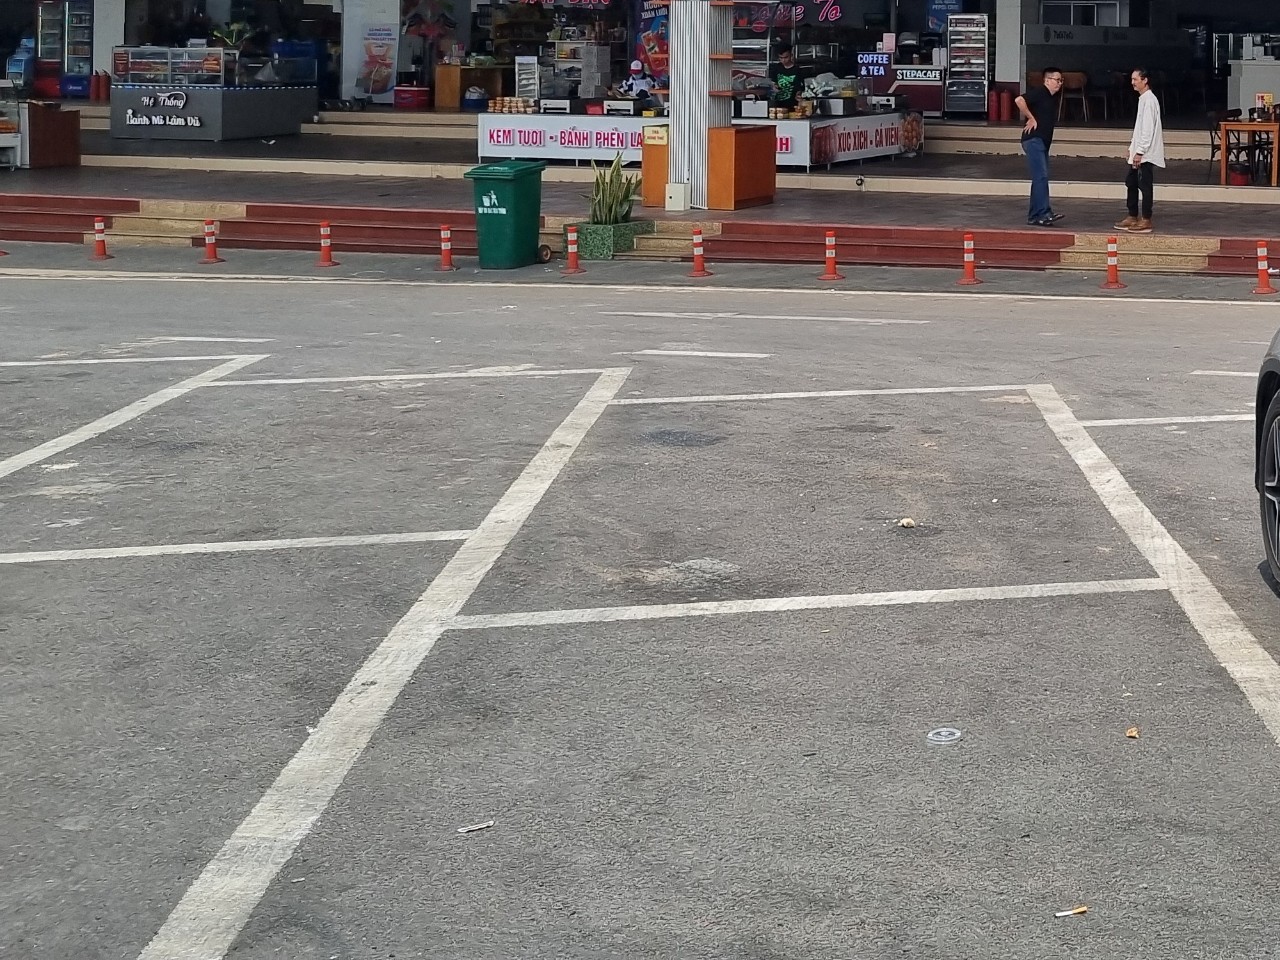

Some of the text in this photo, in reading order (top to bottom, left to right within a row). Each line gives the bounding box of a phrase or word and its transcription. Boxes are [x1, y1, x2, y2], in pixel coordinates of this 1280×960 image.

[857, 54, 889, 64] COFFEE
[869, 66, 885, 75] TEA
[896, 70, 941, 80] STEPACAFE
[489, 129, 512, 144] KEM
